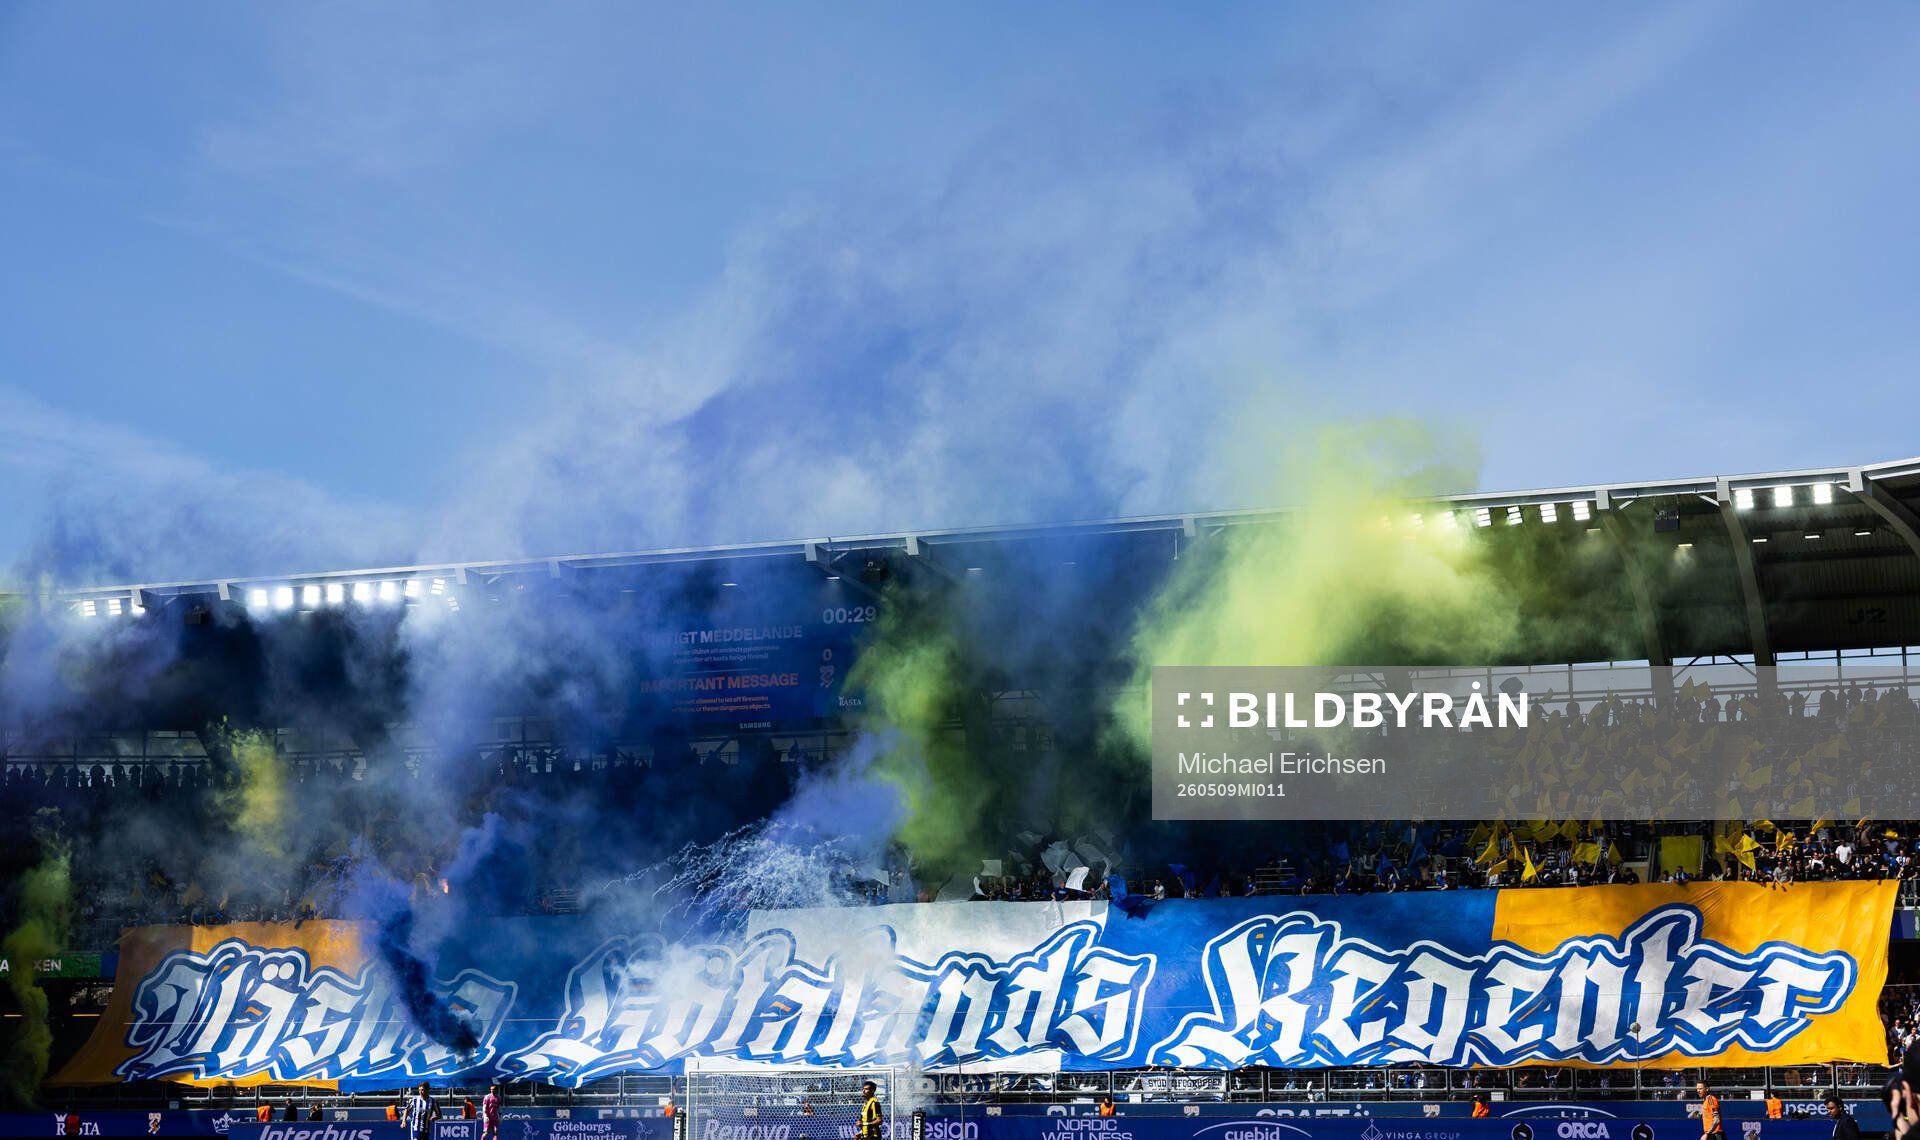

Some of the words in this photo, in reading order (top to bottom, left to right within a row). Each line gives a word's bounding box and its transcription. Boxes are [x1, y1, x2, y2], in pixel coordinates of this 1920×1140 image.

[822, 605, 877, 624] 00:29
[699, 625, 803, 643] MEDDELANDE
[822, 648, 832, 661] 0
[640, 676, 725, 693] IMPORTANT
[727, 673, 799, 690] MESSAGE
[739, 721, 772, 729] SAMSUNG
[116, 938, 518, 1082] Västa
[1145, 905, 1857, 1068] Regenter
[56, 1122, 101, 1136] RTA
[553, 1121, 612, 1133] Göteborgs
[1057, 1119, 1118, 1131] NORDIC
[1557, 1122, 1610, 1139] ORCA
[260, 1124, 373, 1140] Interbus
[440, 1126, 469, 1138] MCR
[1224, 1127, 1280, 1140] cuebid
[1386, 1131, 1421, 1140] VINGA
[1424, 1131, 1462, 1140] GROUP
